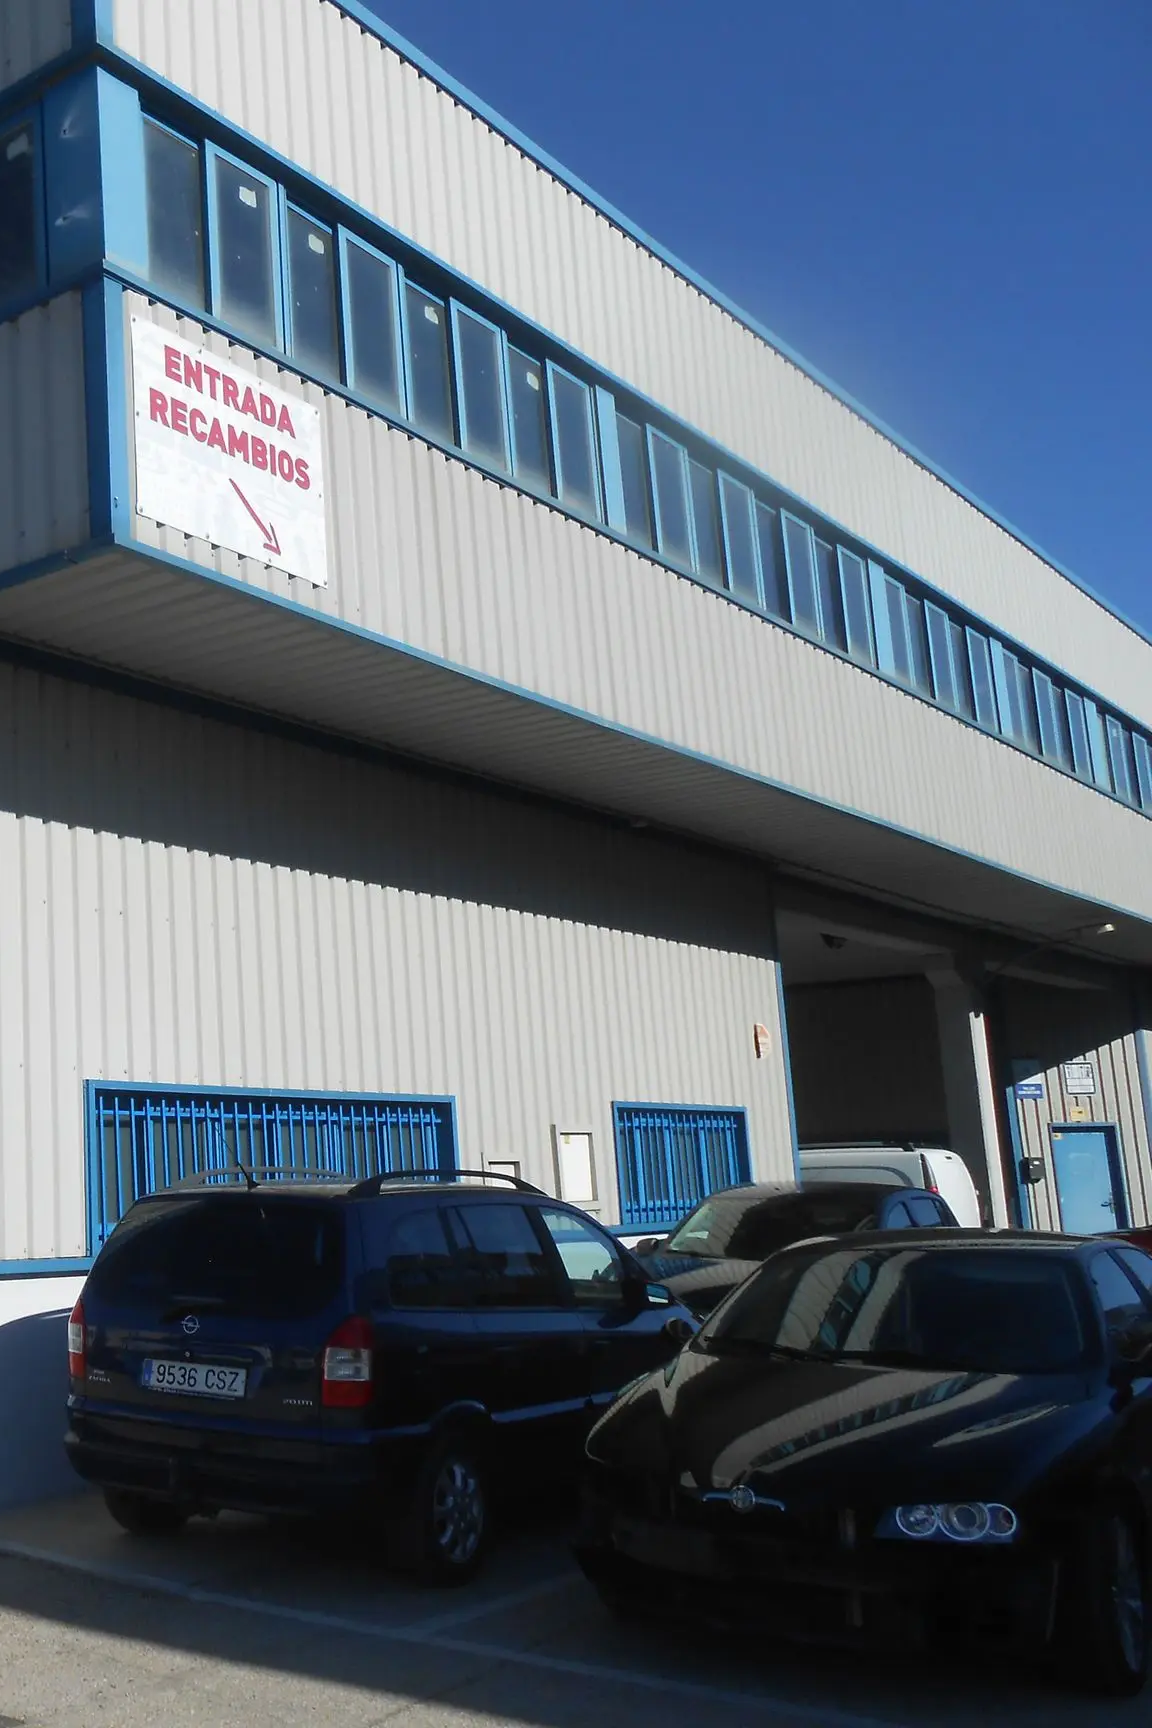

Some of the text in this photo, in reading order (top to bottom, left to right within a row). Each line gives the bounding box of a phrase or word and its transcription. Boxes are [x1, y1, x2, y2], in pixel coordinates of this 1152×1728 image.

[149, 387, 311, 490] RECAMBIOS
[164, 344, 296, 439] ENTRADA
[156, 1364, 240, 1392] 9536 CSZ
